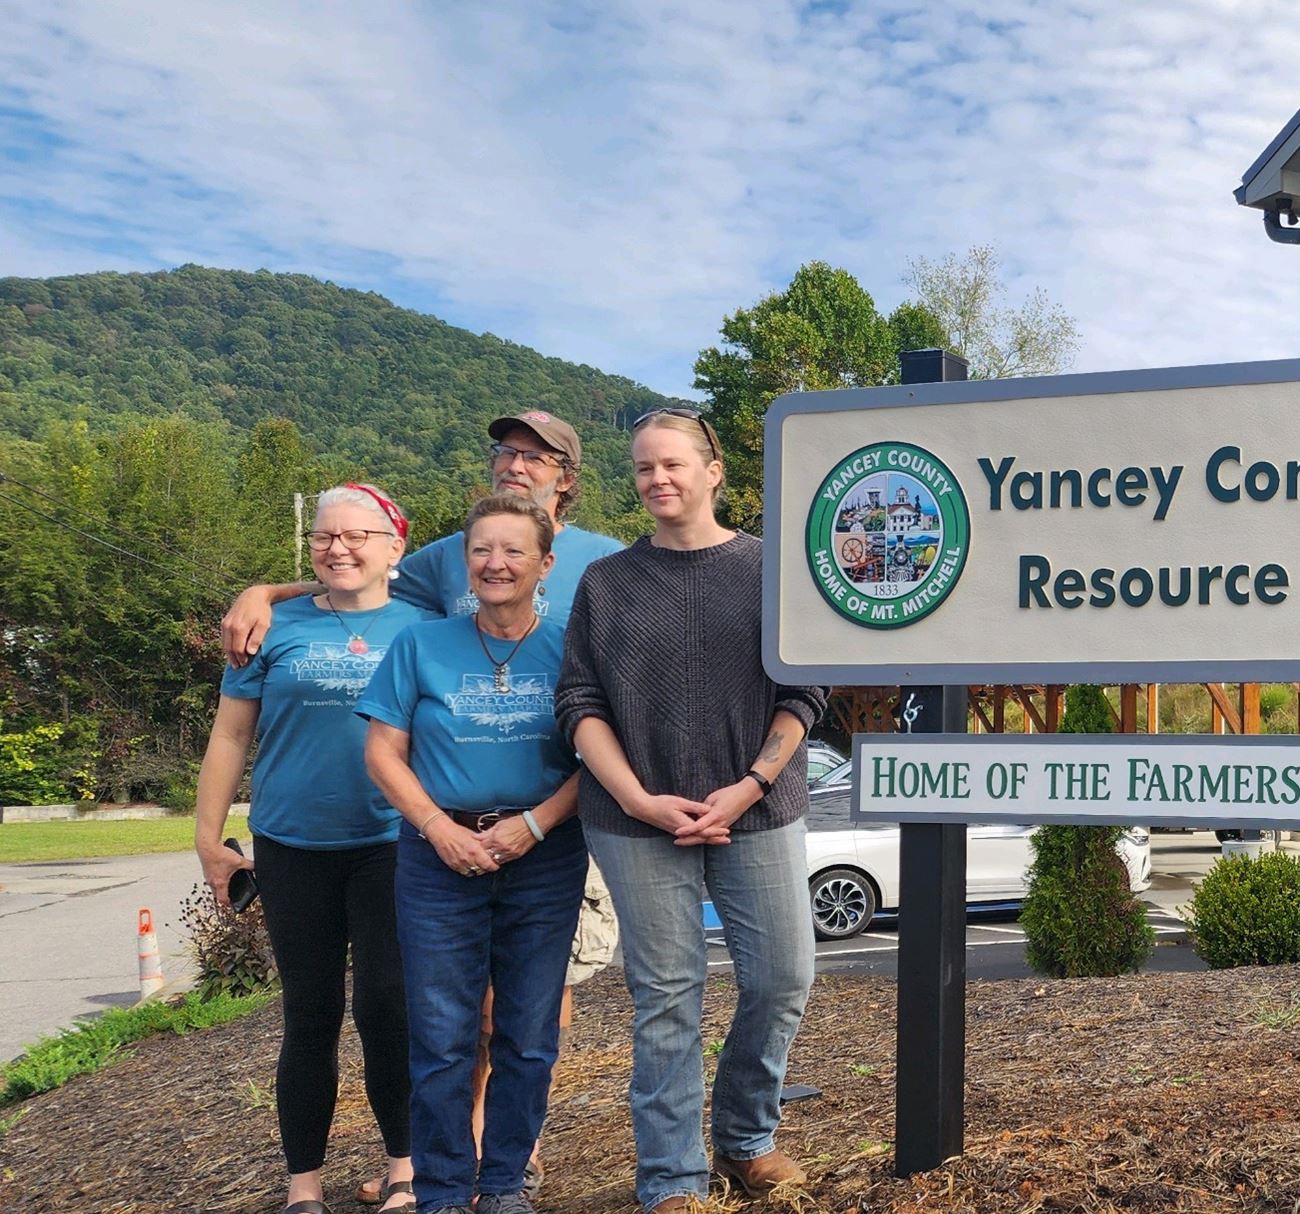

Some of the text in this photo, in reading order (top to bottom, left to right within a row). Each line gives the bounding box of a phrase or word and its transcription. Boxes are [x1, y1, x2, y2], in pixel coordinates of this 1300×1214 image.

[823, 449, 953, 501] YANCEY COUNTY
[977, 456, 1184, 520] Yancey
[815, 546, 961, 620] HOME OF MT. MITCHELL
[873, 584, 899, 596] 1833
[1018, 554, 1290, 609] Resource
[293, 659, 349, 671] YANCEY
[447, 693, 554, 706] YANCEY COUNT
[871, 756, 972, 799] HOME
[986, 762, 1029, 800] OF
[1044, 763, 1112, 801] THE
